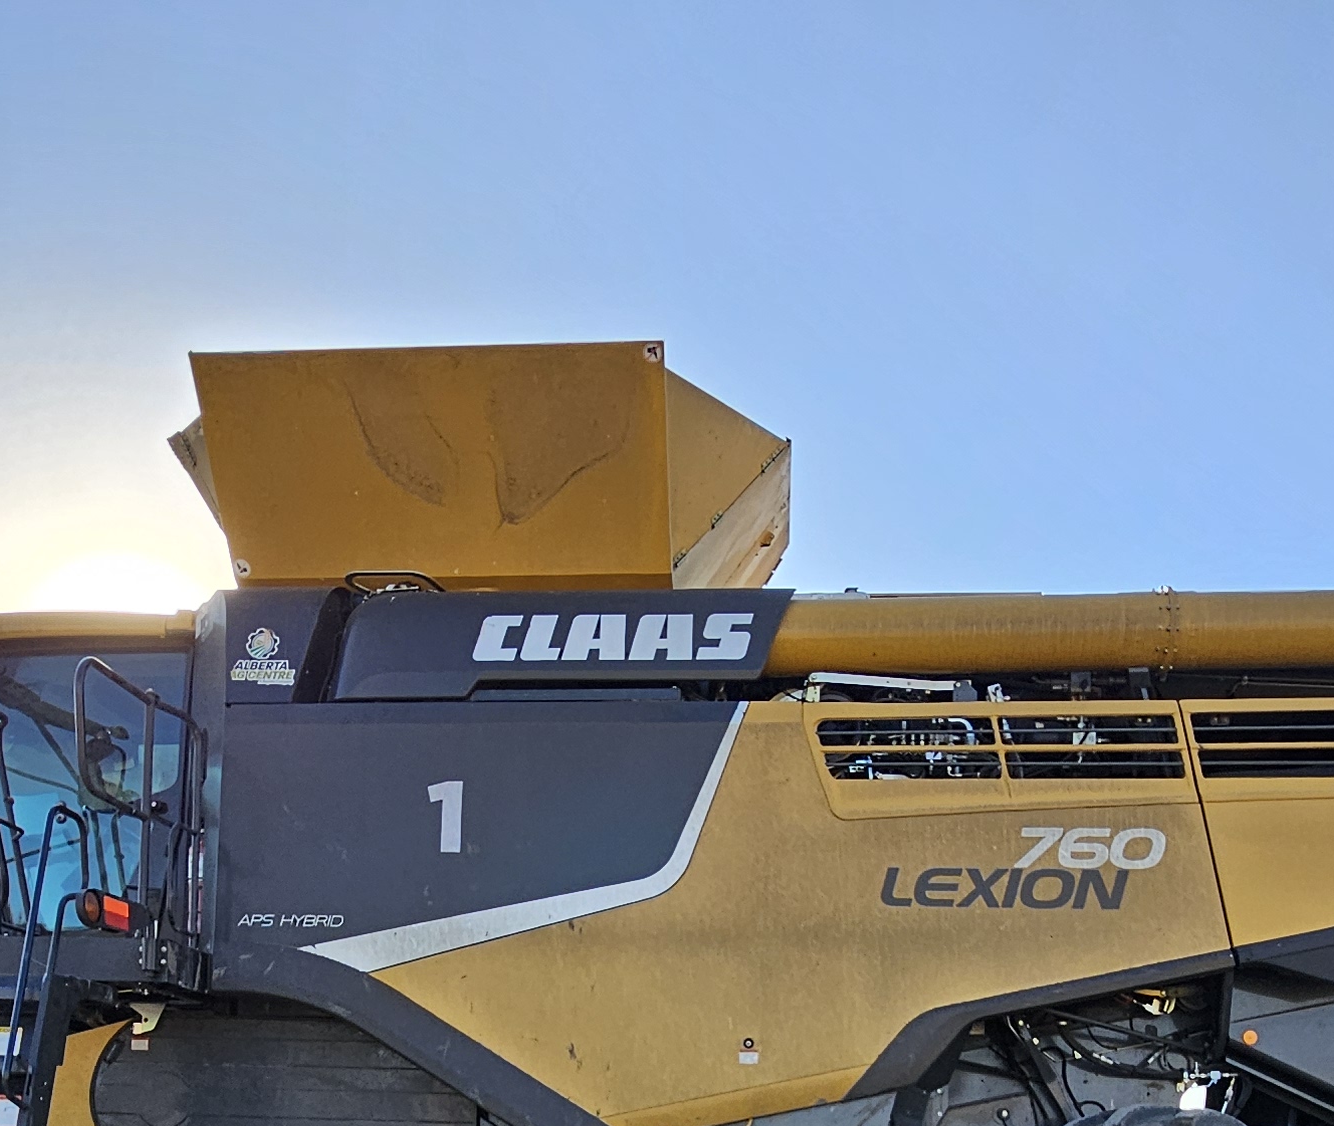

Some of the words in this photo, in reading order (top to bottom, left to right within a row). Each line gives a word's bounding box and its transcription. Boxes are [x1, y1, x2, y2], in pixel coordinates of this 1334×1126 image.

[472, 613, 754, 661] CLAAS
[234, 661, 288, 670] ALBERTA
[248, 670, 293, 680] CENTRE
[428, 780, 463, 853] 1
[1014, 827, 1166, 870] 760
[880, 866, 1129, 909] LEXION
[237, 914, 275, 927] APS
[279, 914, 344, 928] HYBRID
